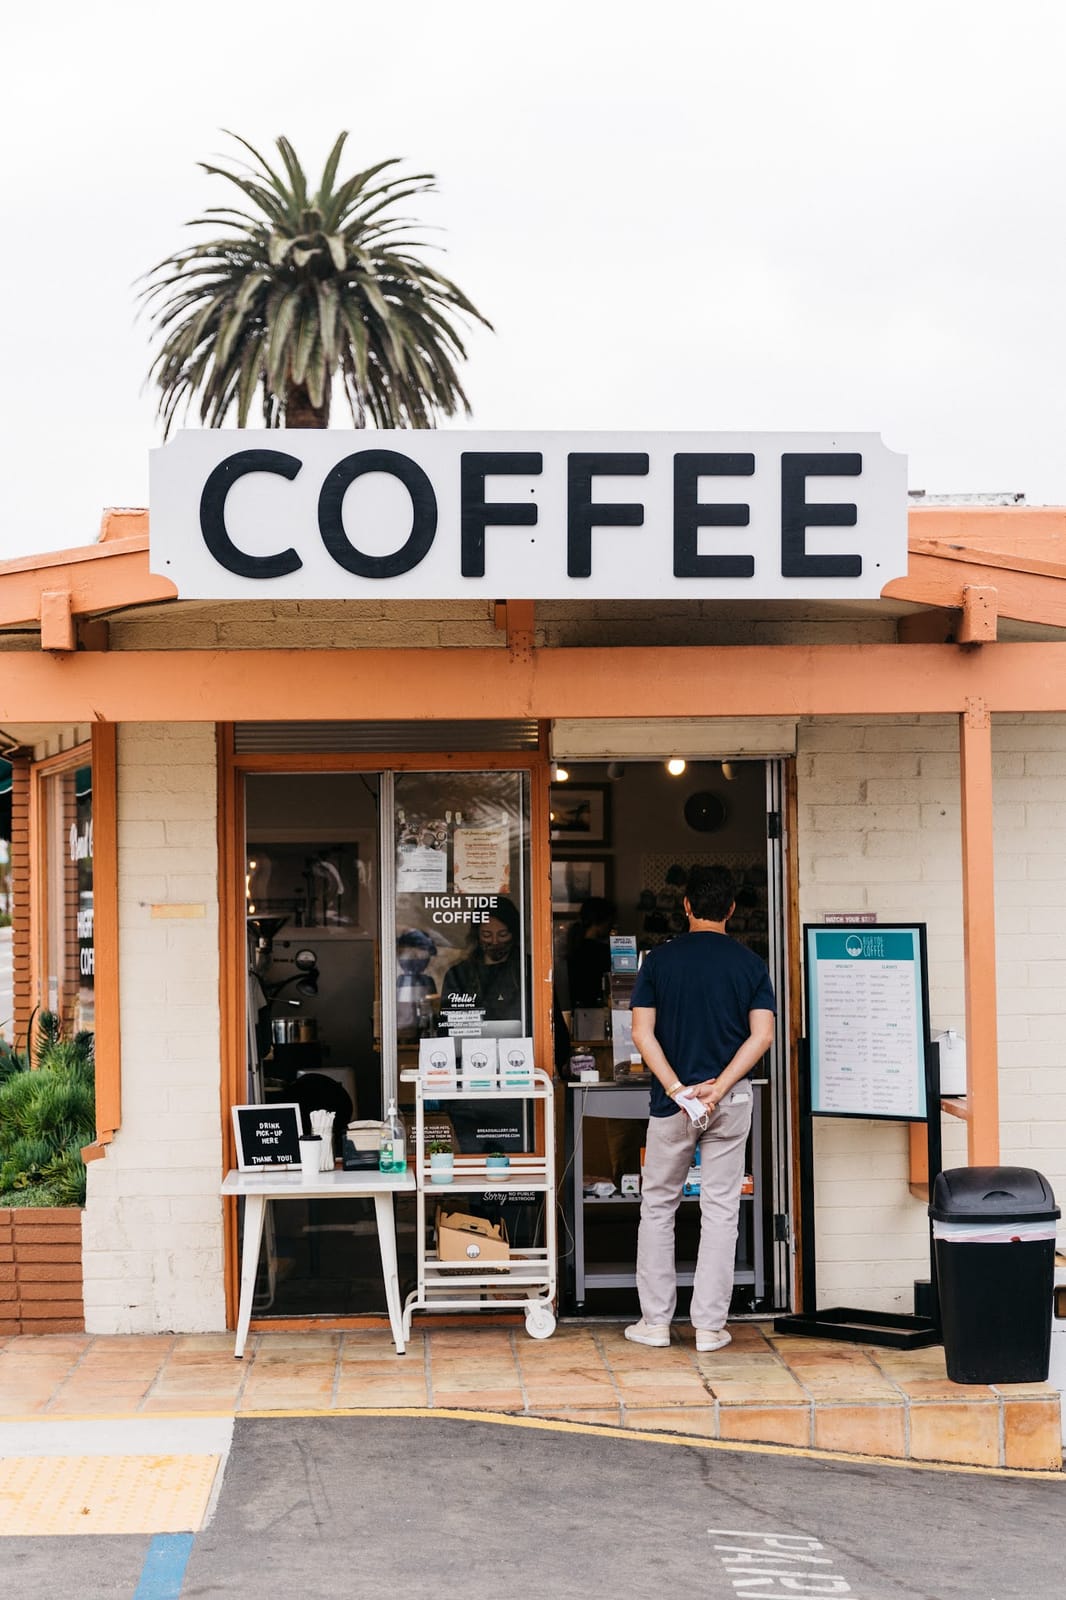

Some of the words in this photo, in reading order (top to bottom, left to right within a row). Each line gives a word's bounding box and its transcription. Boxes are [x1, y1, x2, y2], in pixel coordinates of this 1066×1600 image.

[199, 448, 863, 579] COFFEE
[424, 896, 461, 909] HIGH
[465, 896, 498, 909] TIDE
[432, 911, 490, 924] COFFEE
[863, 944, 884, 958] COFFEE
[447, 992, 477, 1003] Hello!
[261, 1137, 279, 1145] HERE
[251, 1156, 272, 1164] THANK
[276, 1154, 293, 1163] YOU!
[482, 1191, 508, 1206] Sorry
